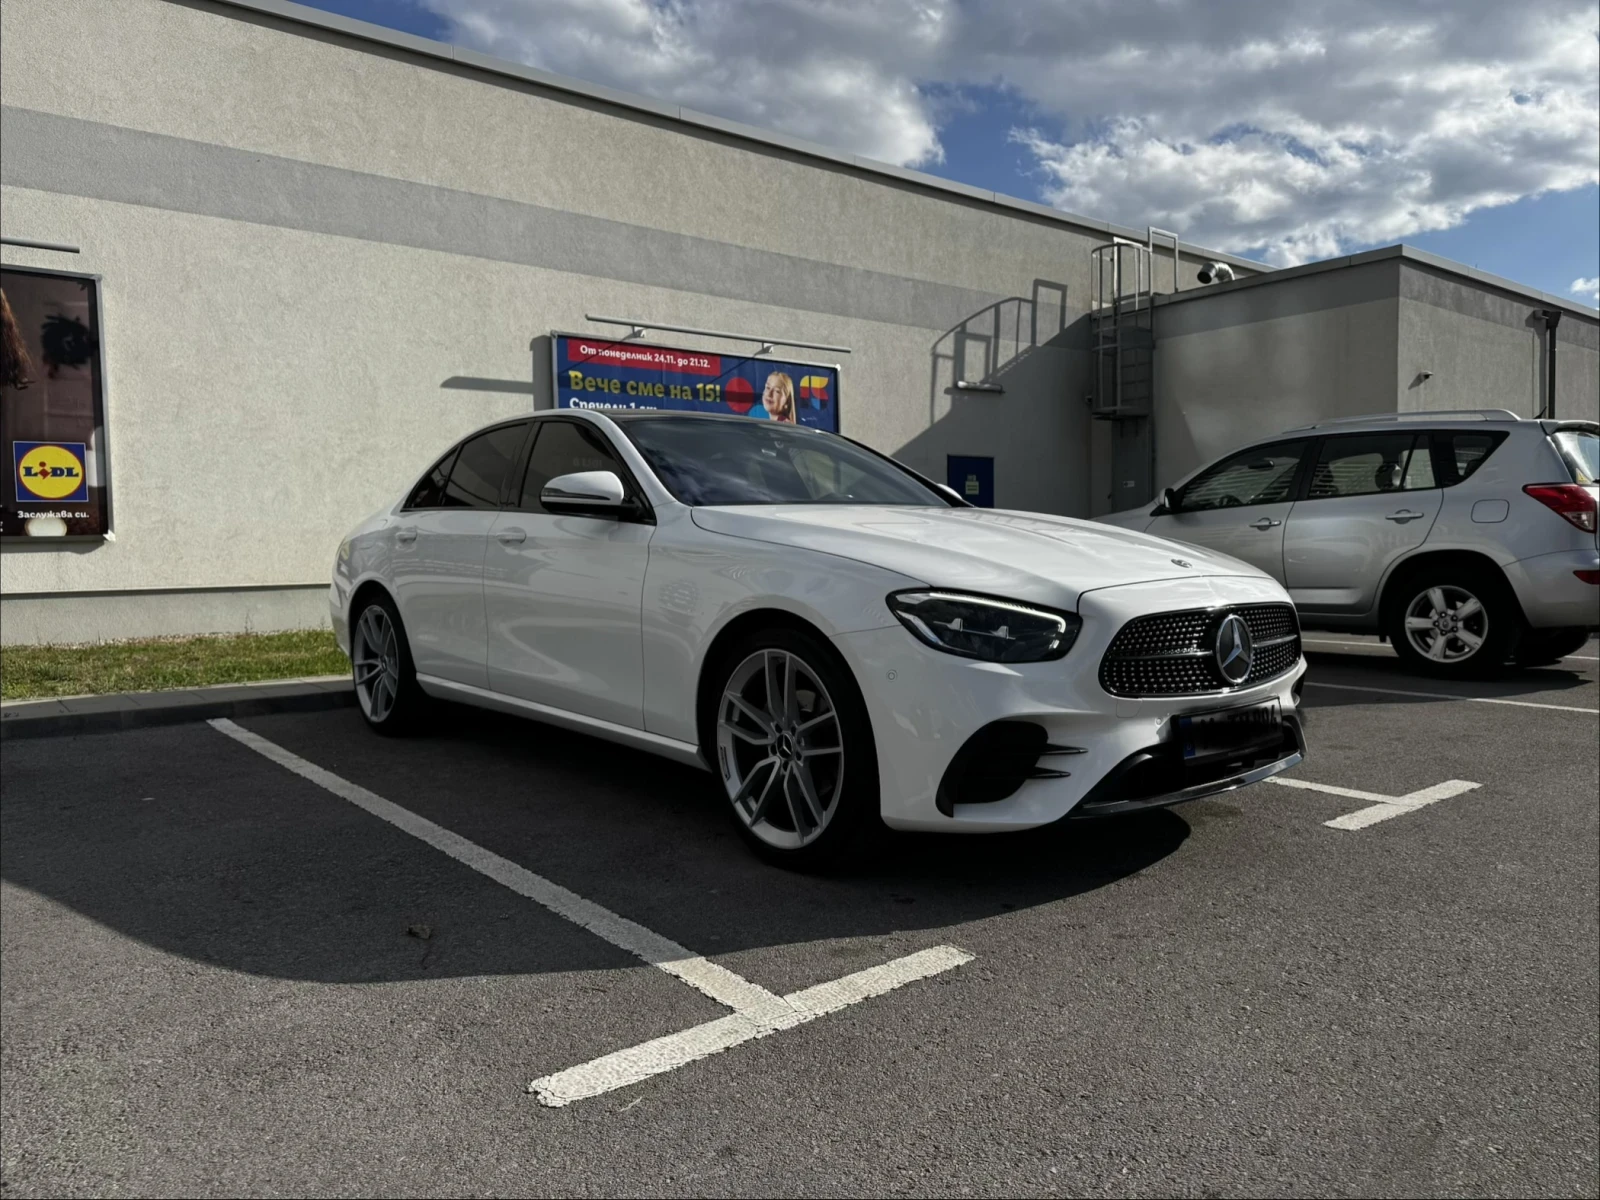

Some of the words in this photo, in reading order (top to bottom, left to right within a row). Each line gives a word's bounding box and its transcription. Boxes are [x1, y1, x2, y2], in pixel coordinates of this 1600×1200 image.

[580, 345, 597, 355] От
[598, 347, 653, 362] понеделник
[654, 353, 677, 365] 24.11.
[677, 357, 689, 367] до
[690, 357, 711, 368] 21.12.
[568, 370, 621, 394] Вече
[626, 380, 665, 398] сме
[670, 385, 693, 400] на
[696, 383, 721, 402] 15!
[17, 510, 73, 520] Заслужава
